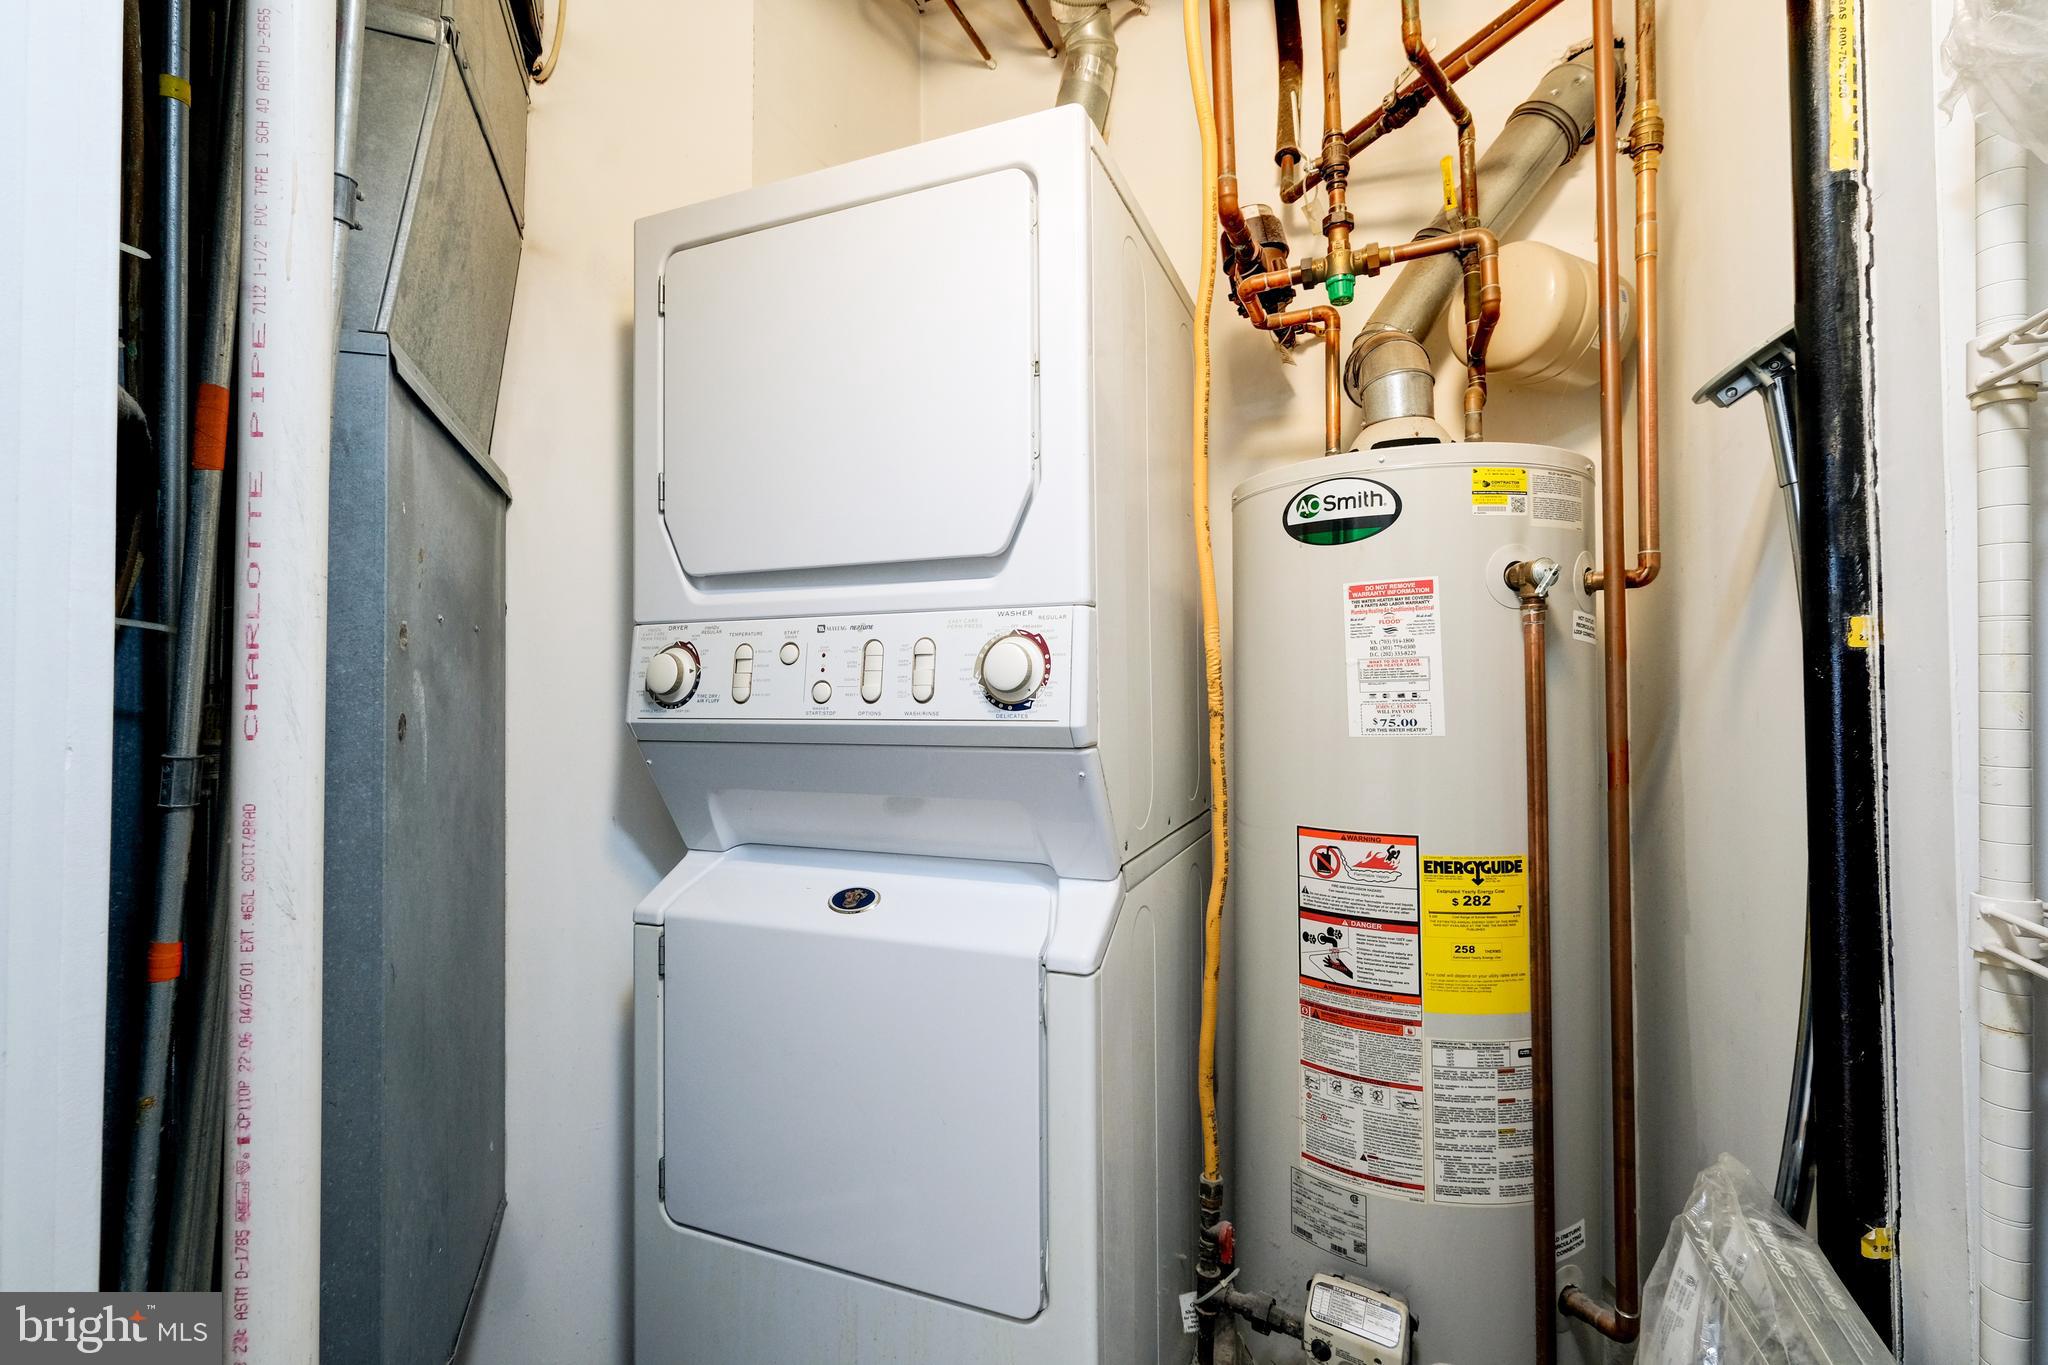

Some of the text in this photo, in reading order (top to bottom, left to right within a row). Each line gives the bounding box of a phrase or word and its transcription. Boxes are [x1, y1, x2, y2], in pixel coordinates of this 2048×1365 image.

[257, 8, 271, 54] D-2665
[257, 60, 271, 92] ASTM
[256, 98, 270, 114] 40
[256, 120, 270, 144] SCH
[255, 167, 268, 196] TYPE
[254, 203, 268, 226] PVC
[253, 285, 266, 315] 7112
[249, 322, 266, 438] PIPE
[1323, 491, 1382, 511] Smith
[243, 471, 263, 741] CHARLOTTE
[1346, 835, 1381, 843] WARNING
[1424, 860, 1522, 875] ENERGYGUIDE
[1452, 895, 1491, 907] $ 282
[1351, 920, 1382, 930] DANGER
[1454, 945, 1475, 953] 258
[235, 1229, 250, 1279] D-1785
[234, 1287, 249, 1321] ASTM
